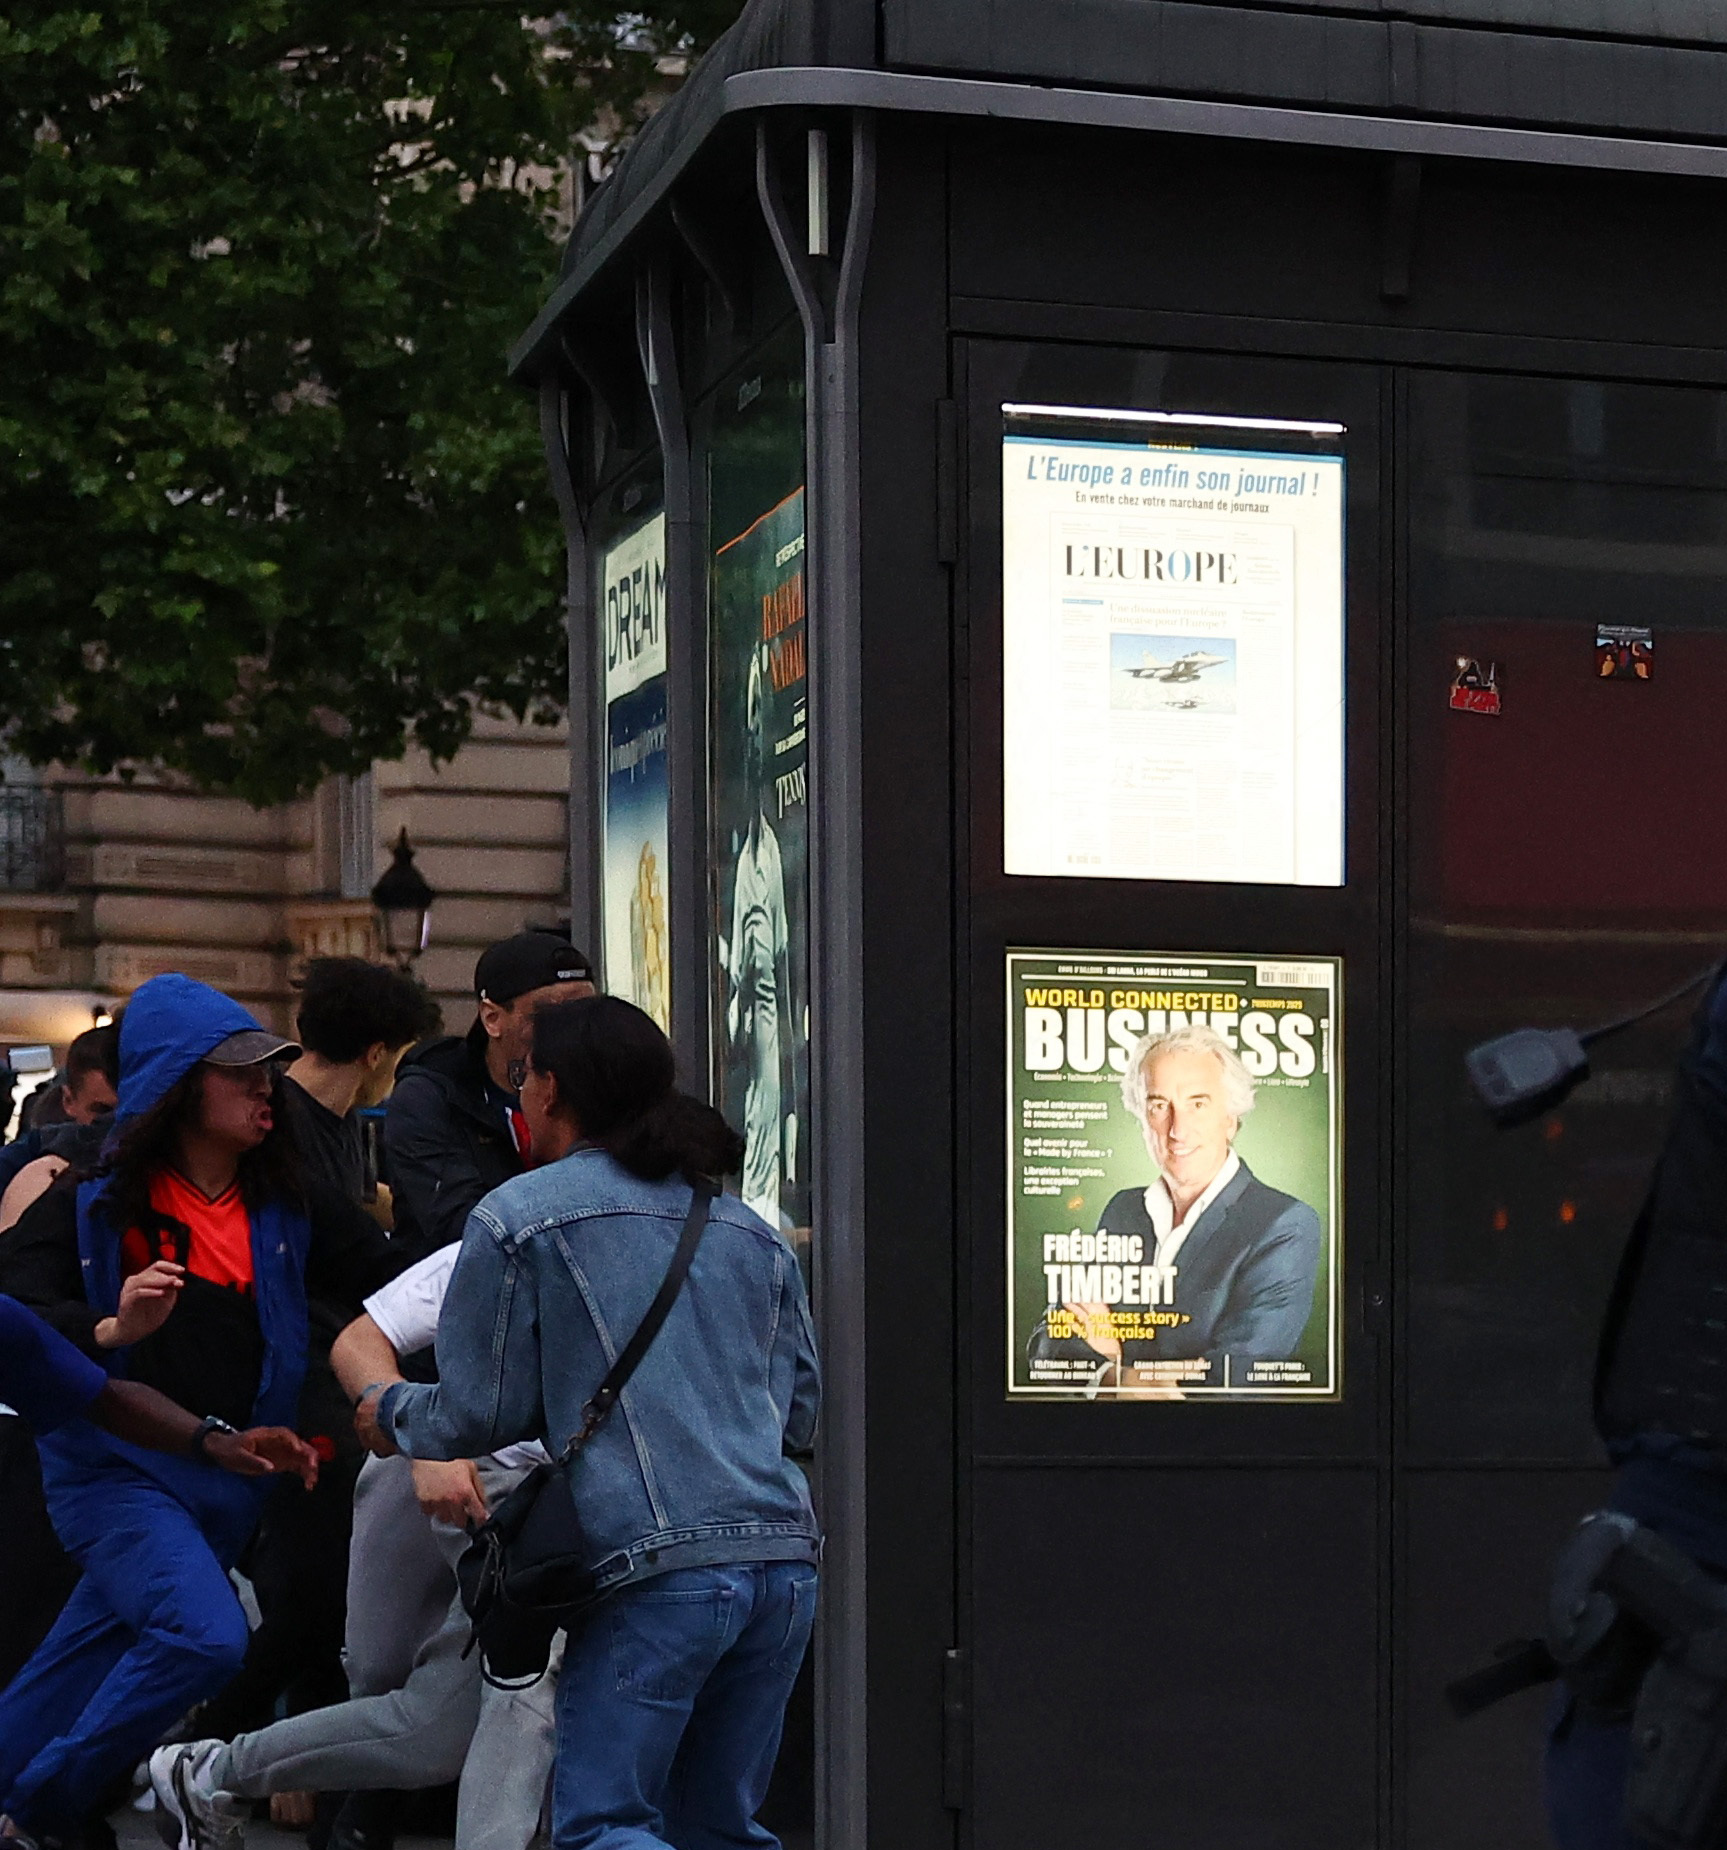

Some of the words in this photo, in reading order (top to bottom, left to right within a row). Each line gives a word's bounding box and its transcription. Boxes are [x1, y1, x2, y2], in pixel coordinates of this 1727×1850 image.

[1027, 455, 1114, 488] L'Europe
[1120, 467, 1132, 486] a
[1139, 464, 1190, 488] enfin
[1196, 470, 1230, 491] son
[1234, 468, 1306, 497] journal
[1311, 473, 1319, 496] !
[1076, 491, 1087, 503] En
[1089, 493, 1115, 504] vente
[1118, 494, 1139, 507] chez
[1142, 497, 1166, 508] votre
[1169, 498, 1214, 510] marchand
[1217, 500, 1228, 511] de
[1230, 501, 1270, 514] journaux
[1066, 544, 1238, 584] L'EUROPE
[1024, 988, 1104, 1008] WORLD
[1110, 990, 1238, 1012] CONNECTED
[1023, 1100, 1050, 1110] Quand
[1050, 1101, 1108, 1111] entrepreneurs
[1034, 1111, 1074, 1120] managers
[1074, 1111, 1108, 1120] pensent
[1024, 1166, 1061, 1176] Librairies
[1043, 1228, 1144, 1263] FRÉDÉRIC
[1043, 1264, 1178, 1304] TIMBERT
[1048, 1310, 1074, 1324] Une
[1143, 1312, 1180, 1328] story
